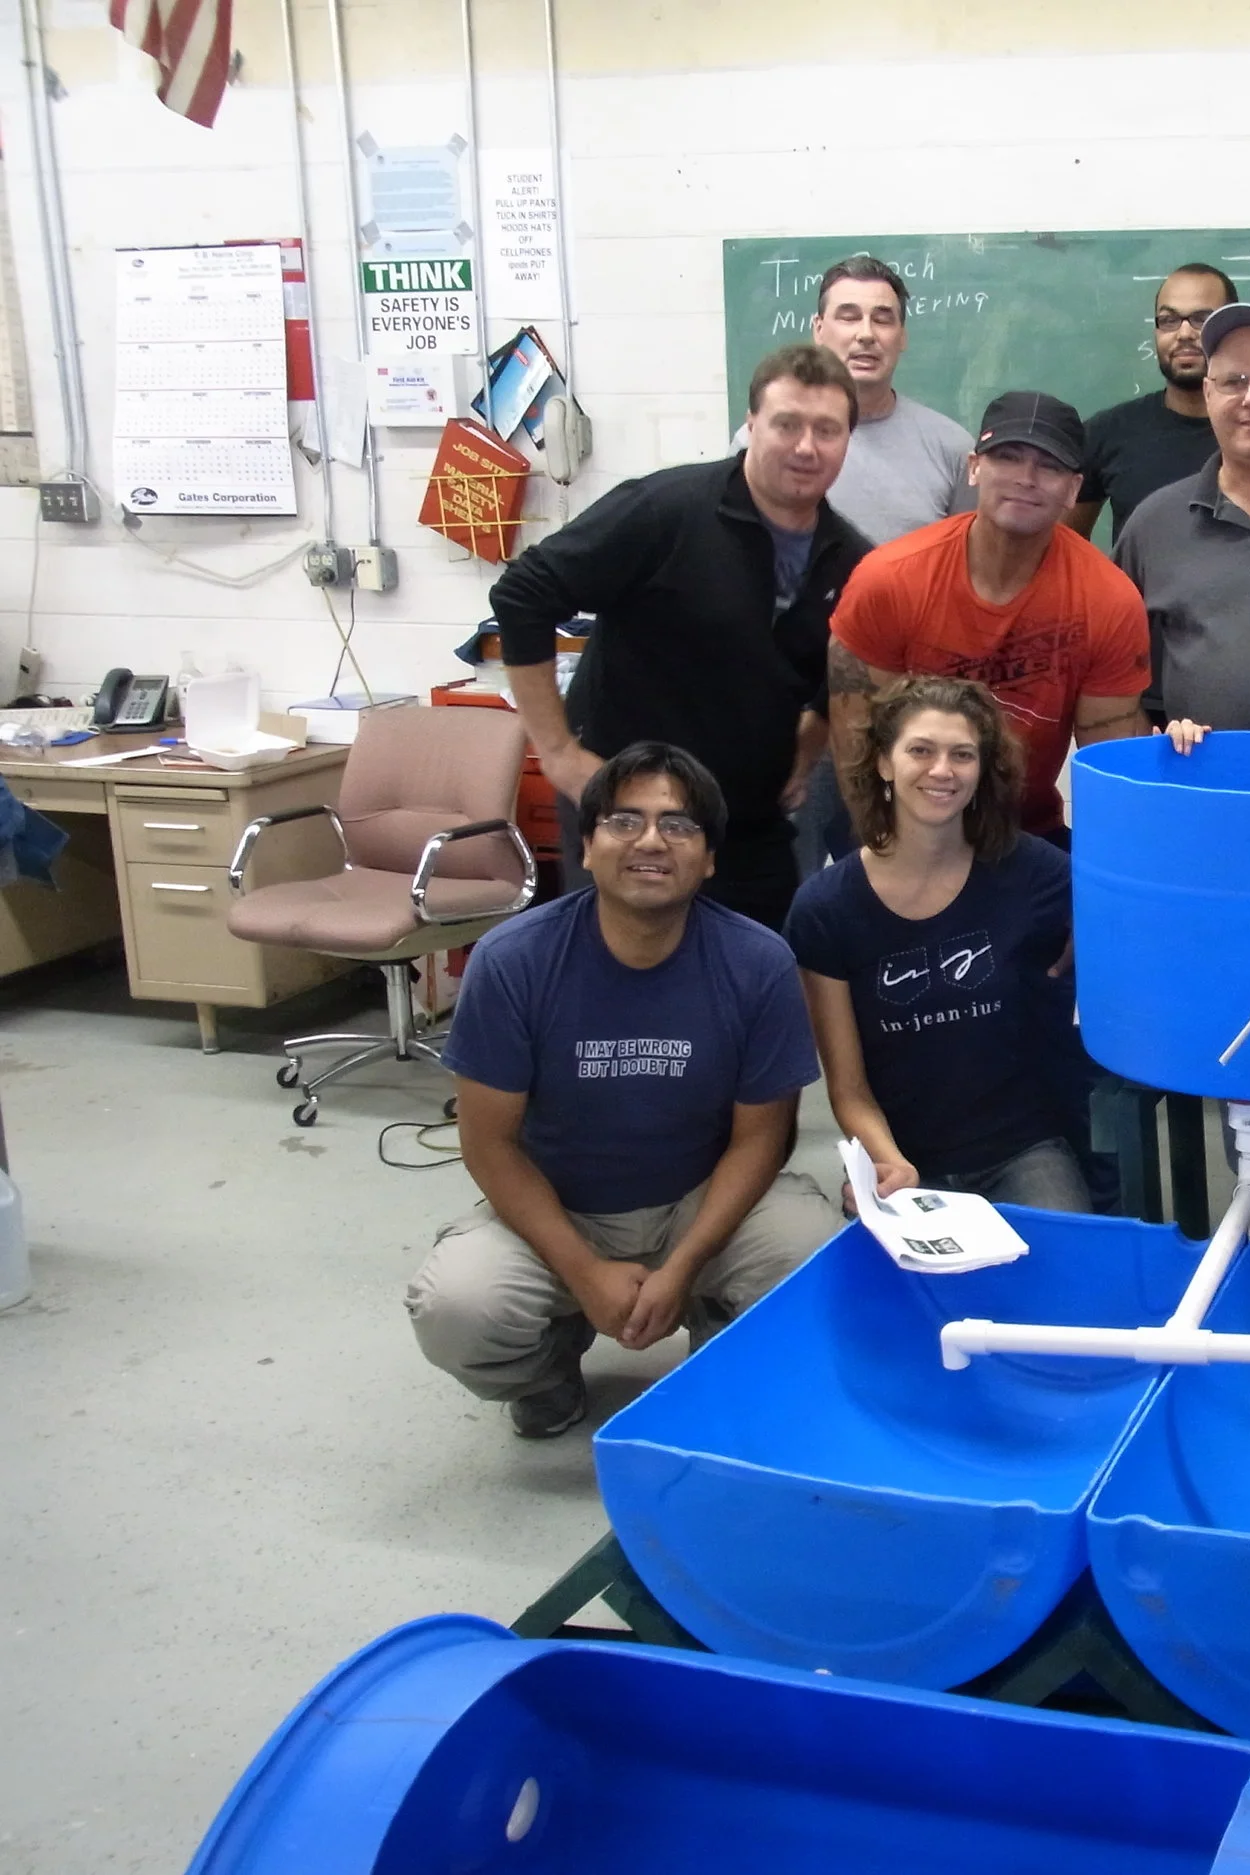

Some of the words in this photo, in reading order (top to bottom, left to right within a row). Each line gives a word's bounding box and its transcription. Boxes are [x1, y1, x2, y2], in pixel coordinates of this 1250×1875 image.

[507, 174, 543, 183] STUDENT
[495, 199, 514, 208] PULL
[517, 199, 528, 208] UP
[530, 199, 556, 208] PANTS
[496, 211, 516, 220] TUCK
[519, 211, 526, 220] IN
[528, 211, 557, 220] SHIRTS
[501, 223, 528, 232] HOODS
[531, 223, 552, 232] HATS
[518, 235, 533, 245] OFF
[500, 248, 552, 257] CELLPHONES
[530, 260, 545, 269] PUT
[368, 261, 466, 291] THINK
[380, 297, 439, 313] SAFETY
[445, 296, 460, 312] IS
[371, 315, 471, 332] EVERYONE'S
[406, 335, 437, 350] JOB
[452, 443, 480, 462] JOB
[444, 462, 505, 506] MAERIAL
[178, 492, 209, 502] Gates
[212, 492, 277, 504] Corporation
[447, 478, 497, 511] SAETY
[575, 1041, 583, 1057] I
[584, 1040, 617, 1058] MAY
[618, 1039, 636, 1057] BE
[637, 1038, 692, 1057] WRONG
[578, 1061, 610, 1078] BUT
[611, 1060, 618, 1077] I
[619, 1057, 668, 1076] DOUBT
[669, 1060, 686, 1077] IT
